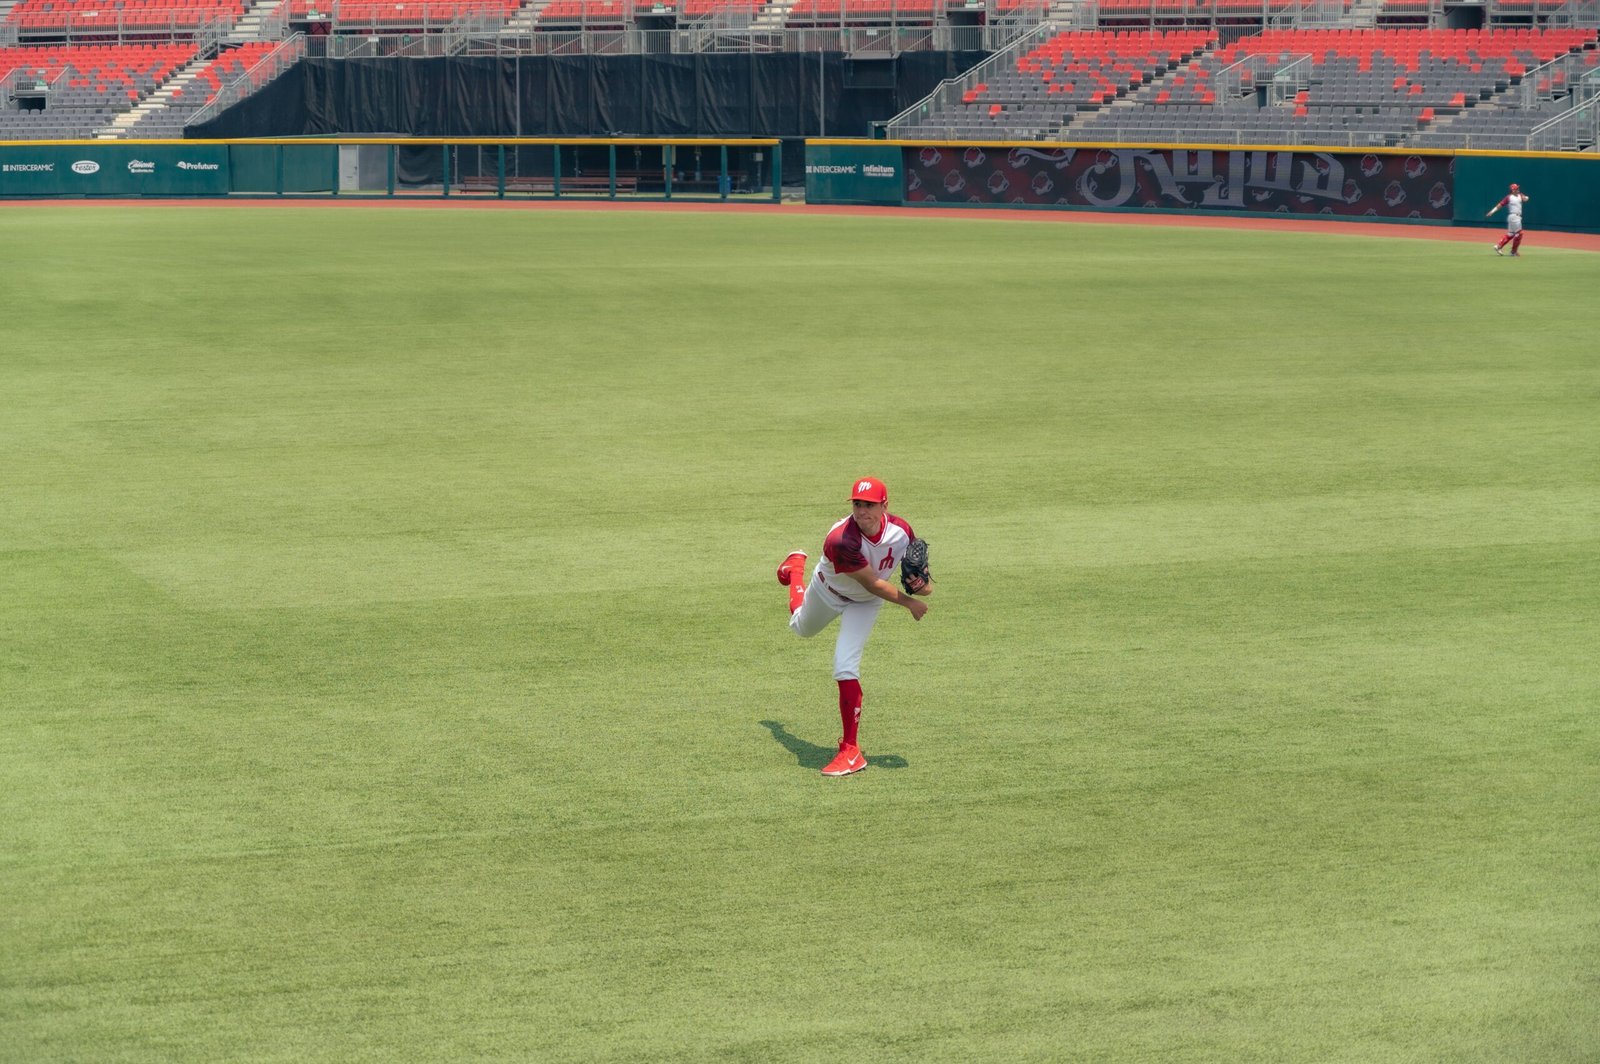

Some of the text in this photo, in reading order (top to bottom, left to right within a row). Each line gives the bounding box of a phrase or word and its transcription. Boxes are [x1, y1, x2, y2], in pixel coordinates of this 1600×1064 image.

[10, 164, 54, 172] INTERCERAMIC
[186, 162, 219, 170] Profuturo
[812, 165, 857, 173] INTERCERAMIC
